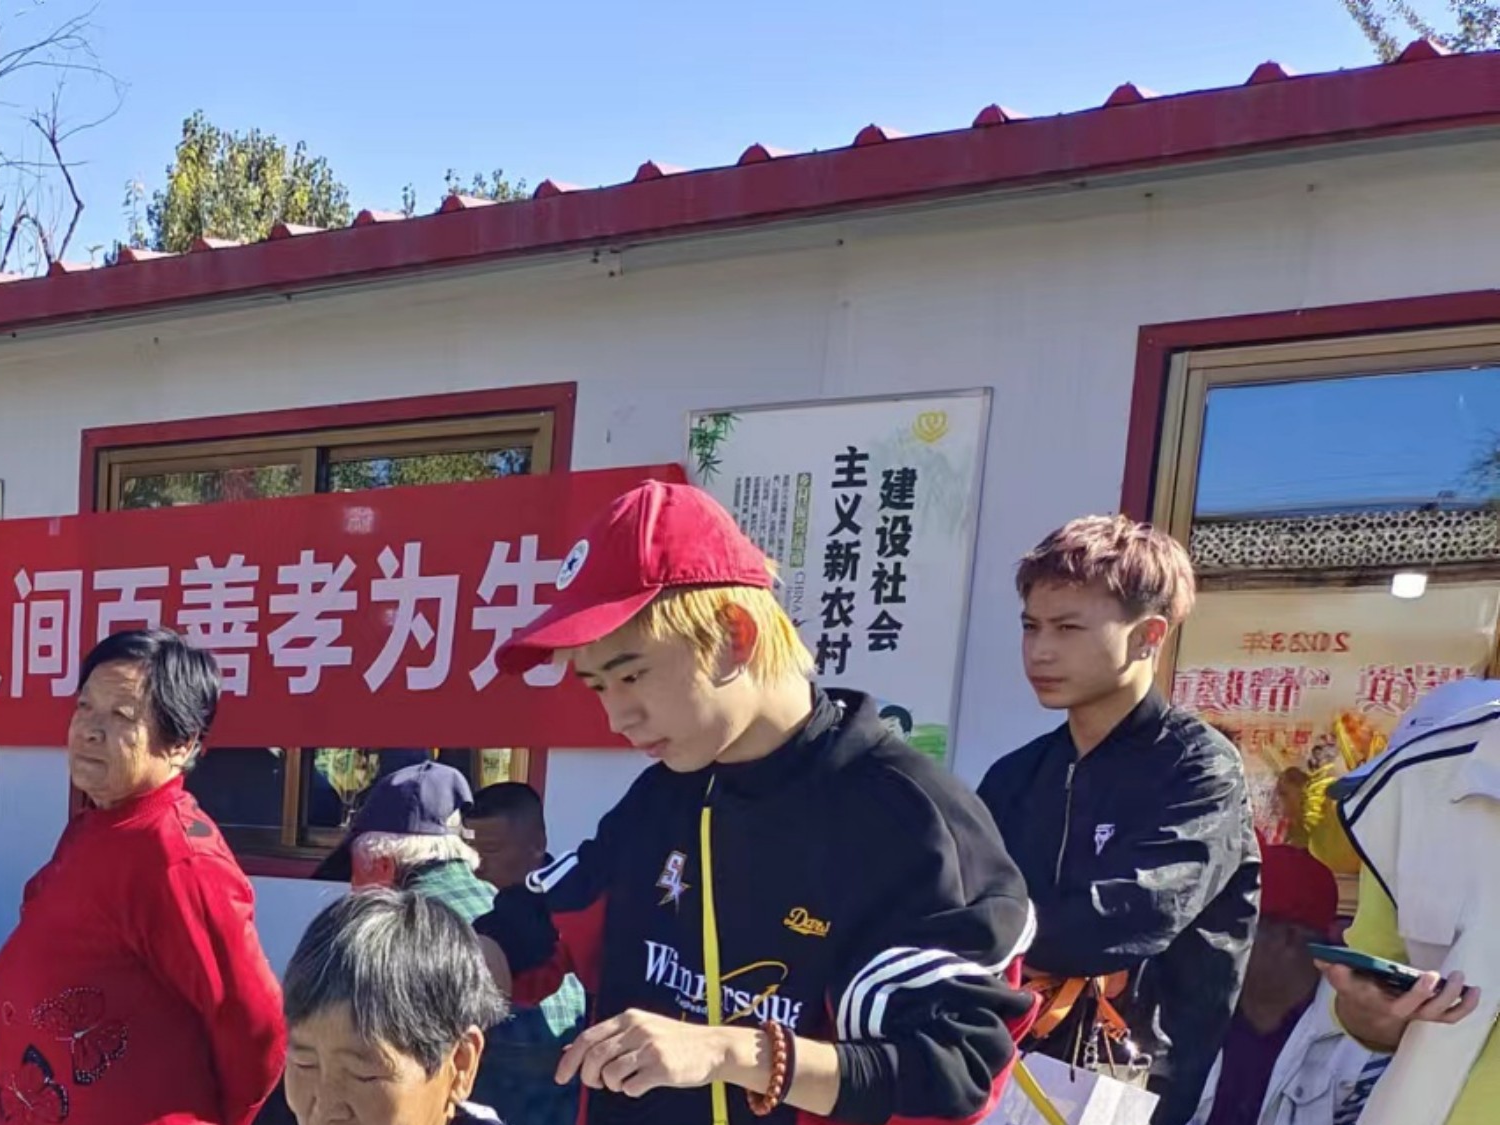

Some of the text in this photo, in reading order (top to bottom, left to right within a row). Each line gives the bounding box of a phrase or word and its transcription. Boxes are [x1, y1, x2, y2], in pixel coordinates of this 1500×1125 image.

[814, 446, 870, 675] 主义新农村
[866, 466, 918, 652] 建设社会
